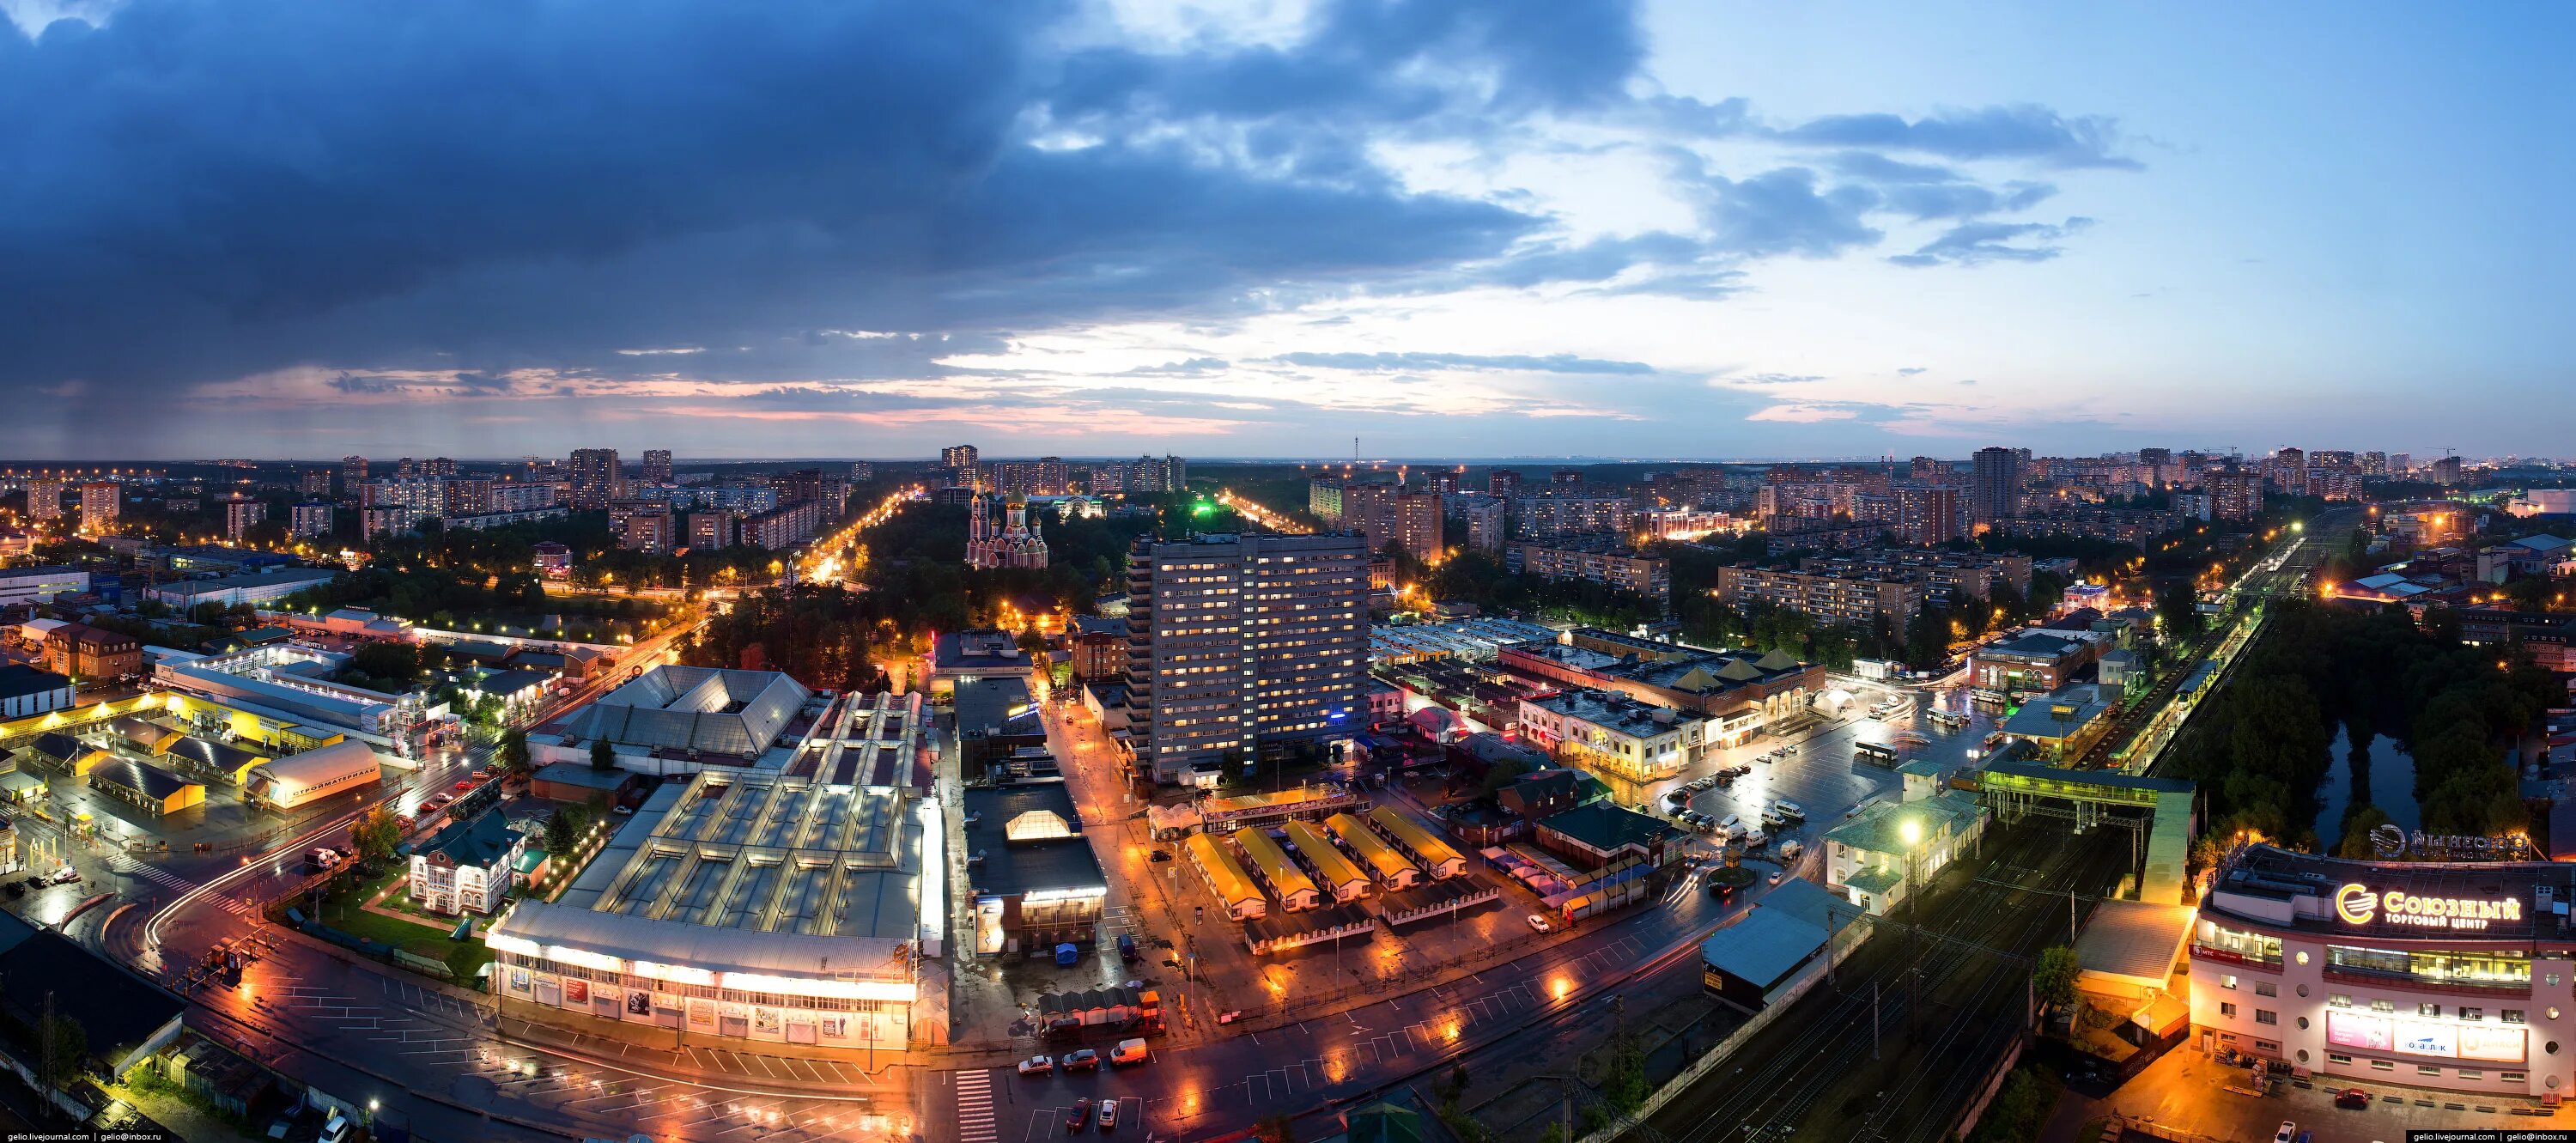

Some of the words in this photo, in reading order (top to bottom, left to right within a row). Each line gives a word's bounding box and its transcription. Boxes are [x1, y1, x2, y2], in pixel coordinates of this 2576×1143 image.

[293, 767, 376, 796] СТРОЙМАТЕРИАЛЫ
[2385, 913, 2447, 927] ТОРГОВЫЙ
[2451, 919, 2488, 930] ЦЕНТР
